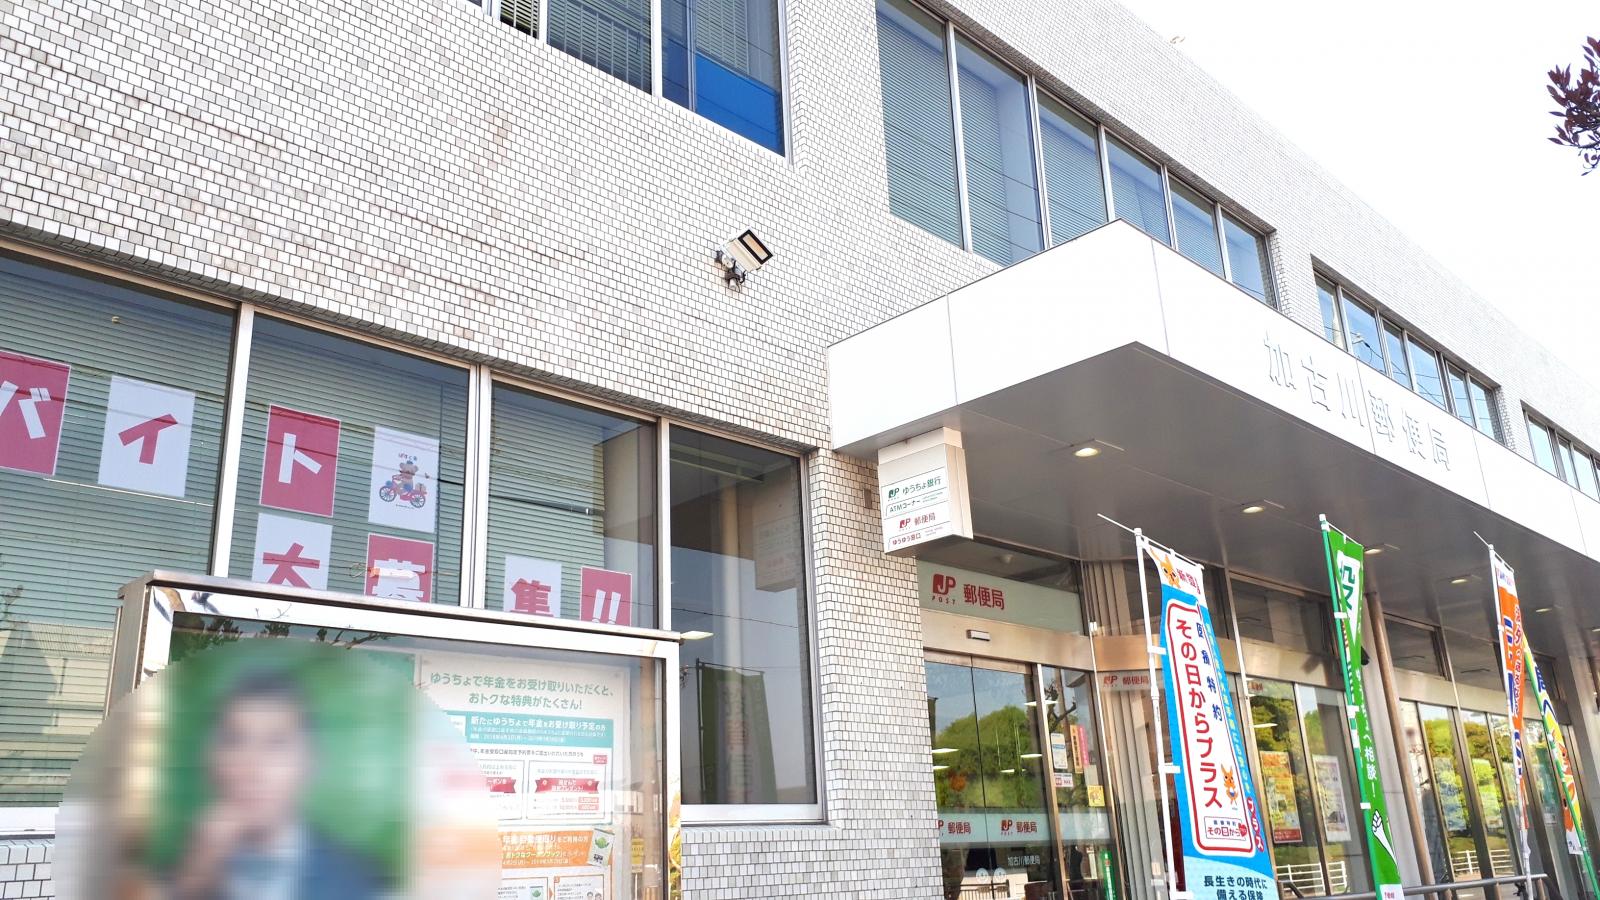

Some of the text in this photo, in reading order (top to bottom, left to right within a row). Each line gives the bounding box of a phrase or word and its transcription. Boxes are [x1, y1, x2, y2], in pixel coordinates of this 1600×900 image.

[1263, 330, 1450, 471] 加古川郵便局
[902, 476, 941, 495] ゆうちょ銀行
[889, 499, 920, 512] ATMコーナー
[914, 512, 936, 526] 郵便局
[892, 532, 921, 545] ゆうゆう窓口
[963, 584, 1005, 610] 郵便局
[431, 672, 614, 696] ゆうちょで年金をお受け取りいただくと、
[469, 692, 582, 710] おトクな特典がたくさん!
[1176, 619, 1222, 809] その日からプラス
[948, 821, 972, 834] 郵便局
[1016, 821, 1038, 833] 郵便局
[1008, 855, 1040, 866] 加古川郵便局
[1204, 875, 1268, 889] 長生きの時代に
